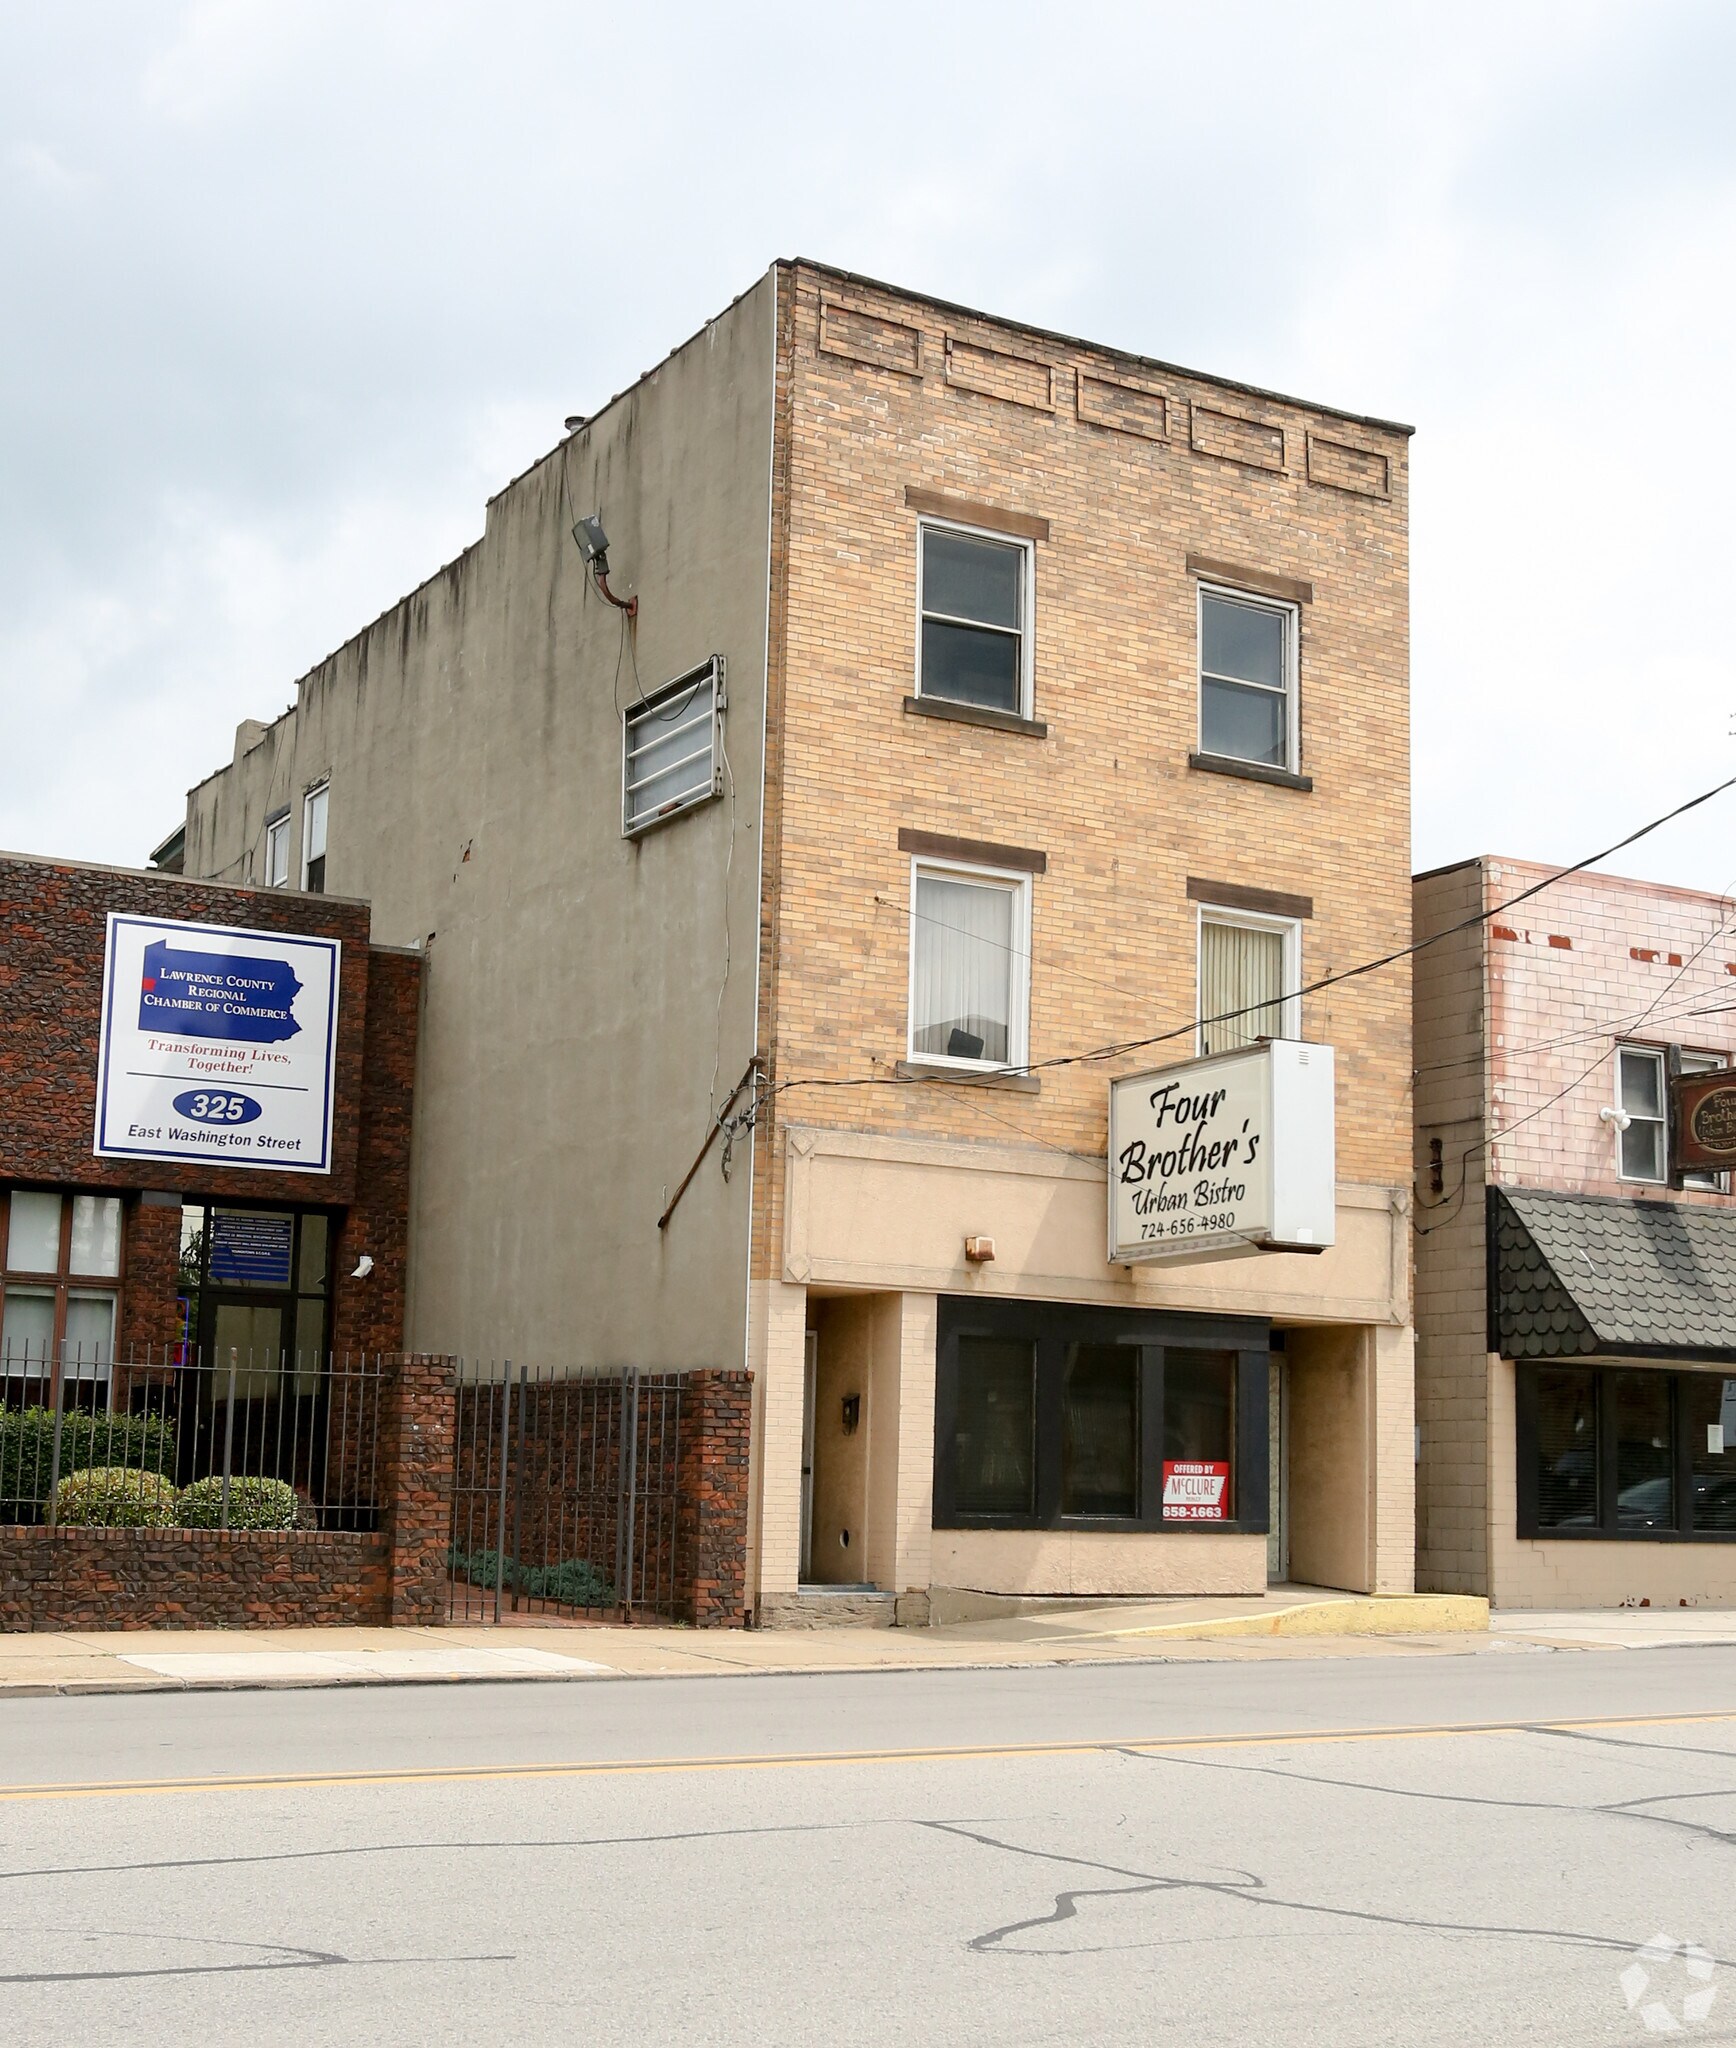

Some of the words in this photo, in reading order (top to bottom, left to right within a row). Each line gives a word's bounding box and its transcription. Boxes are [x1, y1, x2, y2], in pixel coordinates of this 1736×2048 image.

[160, 967, 224, 986] LAWRENCE
[226, 975, 275, 991] COUNTY
[143, 993, 202, 1011] CHAMBER
[205, 1001, 220, 1012] OF
[223, 1003, 288, 1020] COMMERCE
[188, 984, 247, 1002] REGIONAL
[148, 1038, 247, 1061] Transforming
[251, 1049, 292, 1065] Lives,
[187, 1057, 254, 1075] Together!
[190, 1094, 245, 1120] 325
[1150, 1082, 1226, 1128] Four
[128, 1124, 162, 1139] East
[167, 1127, 251, 1147] Washington
[256, 1135, 302, 1151] Street
[1119, 1118, 1260, 1184] Brother's
[1131, 1181, 1188, 1216] Urban
[1193, 1177, 1246, 1207] Bistro
[1141, 1212, 1236, 1239] 724-656-4980
[1173, 1464, 1204, 1474] OFFERED
[1204, 1464, 1214, 1474] BY
[1162, 1506, 1222, 1518] 658-1663
